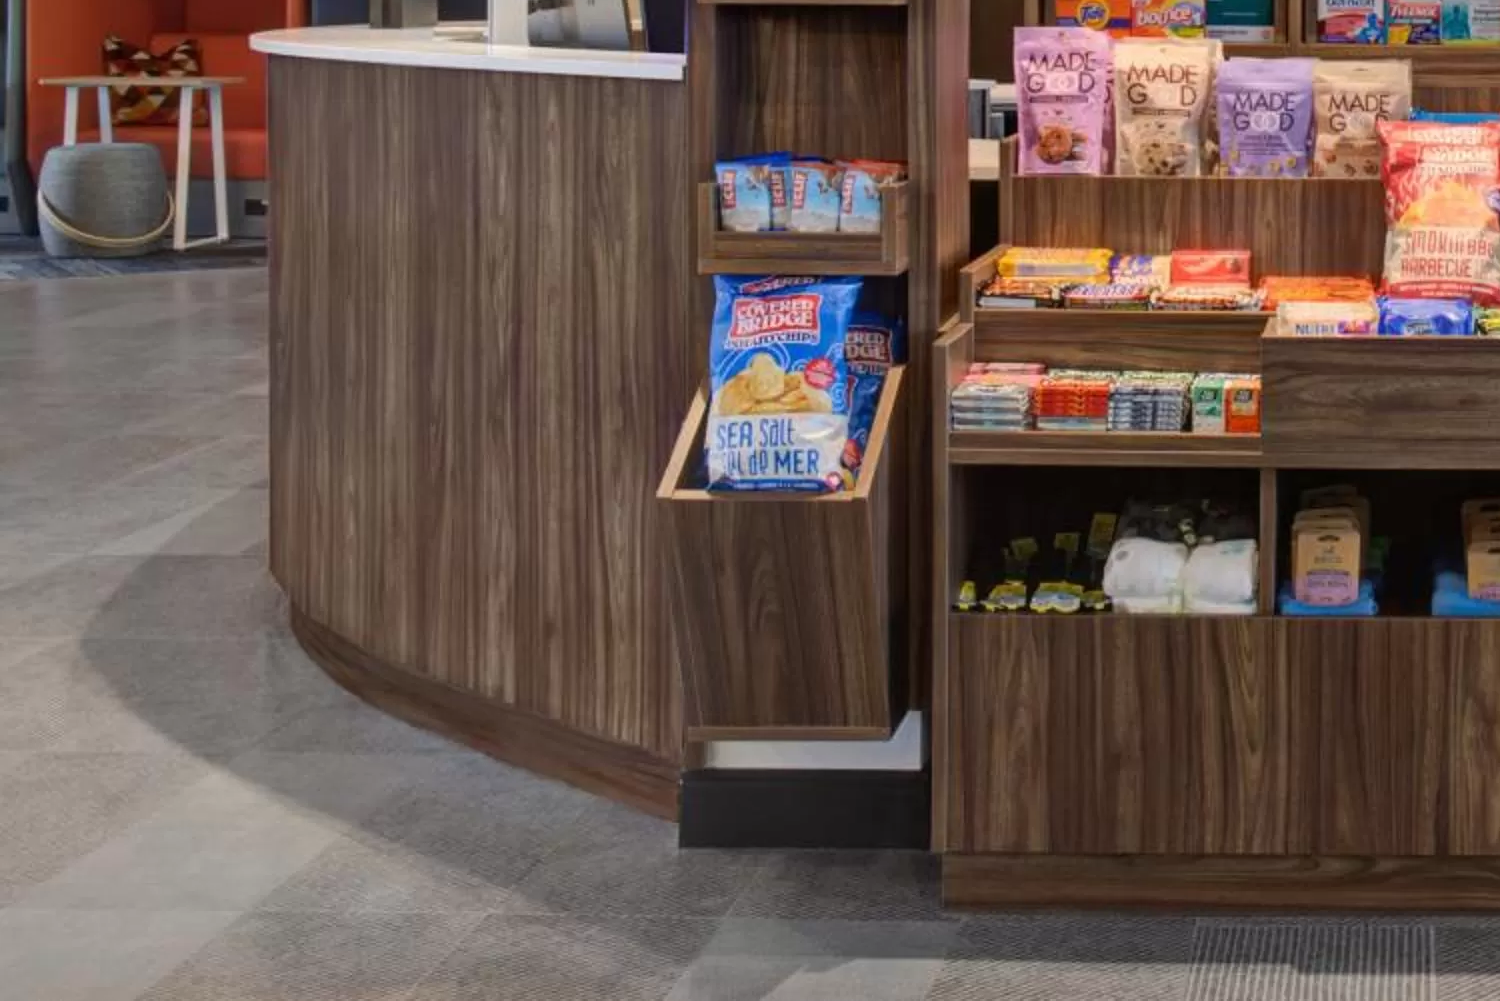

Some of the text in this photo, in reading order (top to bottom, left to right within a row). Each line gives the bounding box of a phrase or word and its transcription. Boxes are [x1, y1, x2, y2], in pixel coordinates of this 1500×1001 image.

[1028, 50, 1097, 72] MADE
[1127, 63, 1199, 84] MADE
[1232, 92, 1296, 112] MADE
[1328, 94, 1391, 112] MADE
[736, 299, 814, 319] COVERED
[736, 311, 814, 335] BRIDGE
[717, 421, 753, 449] SEA
[774, 449, 821, 474] MER
